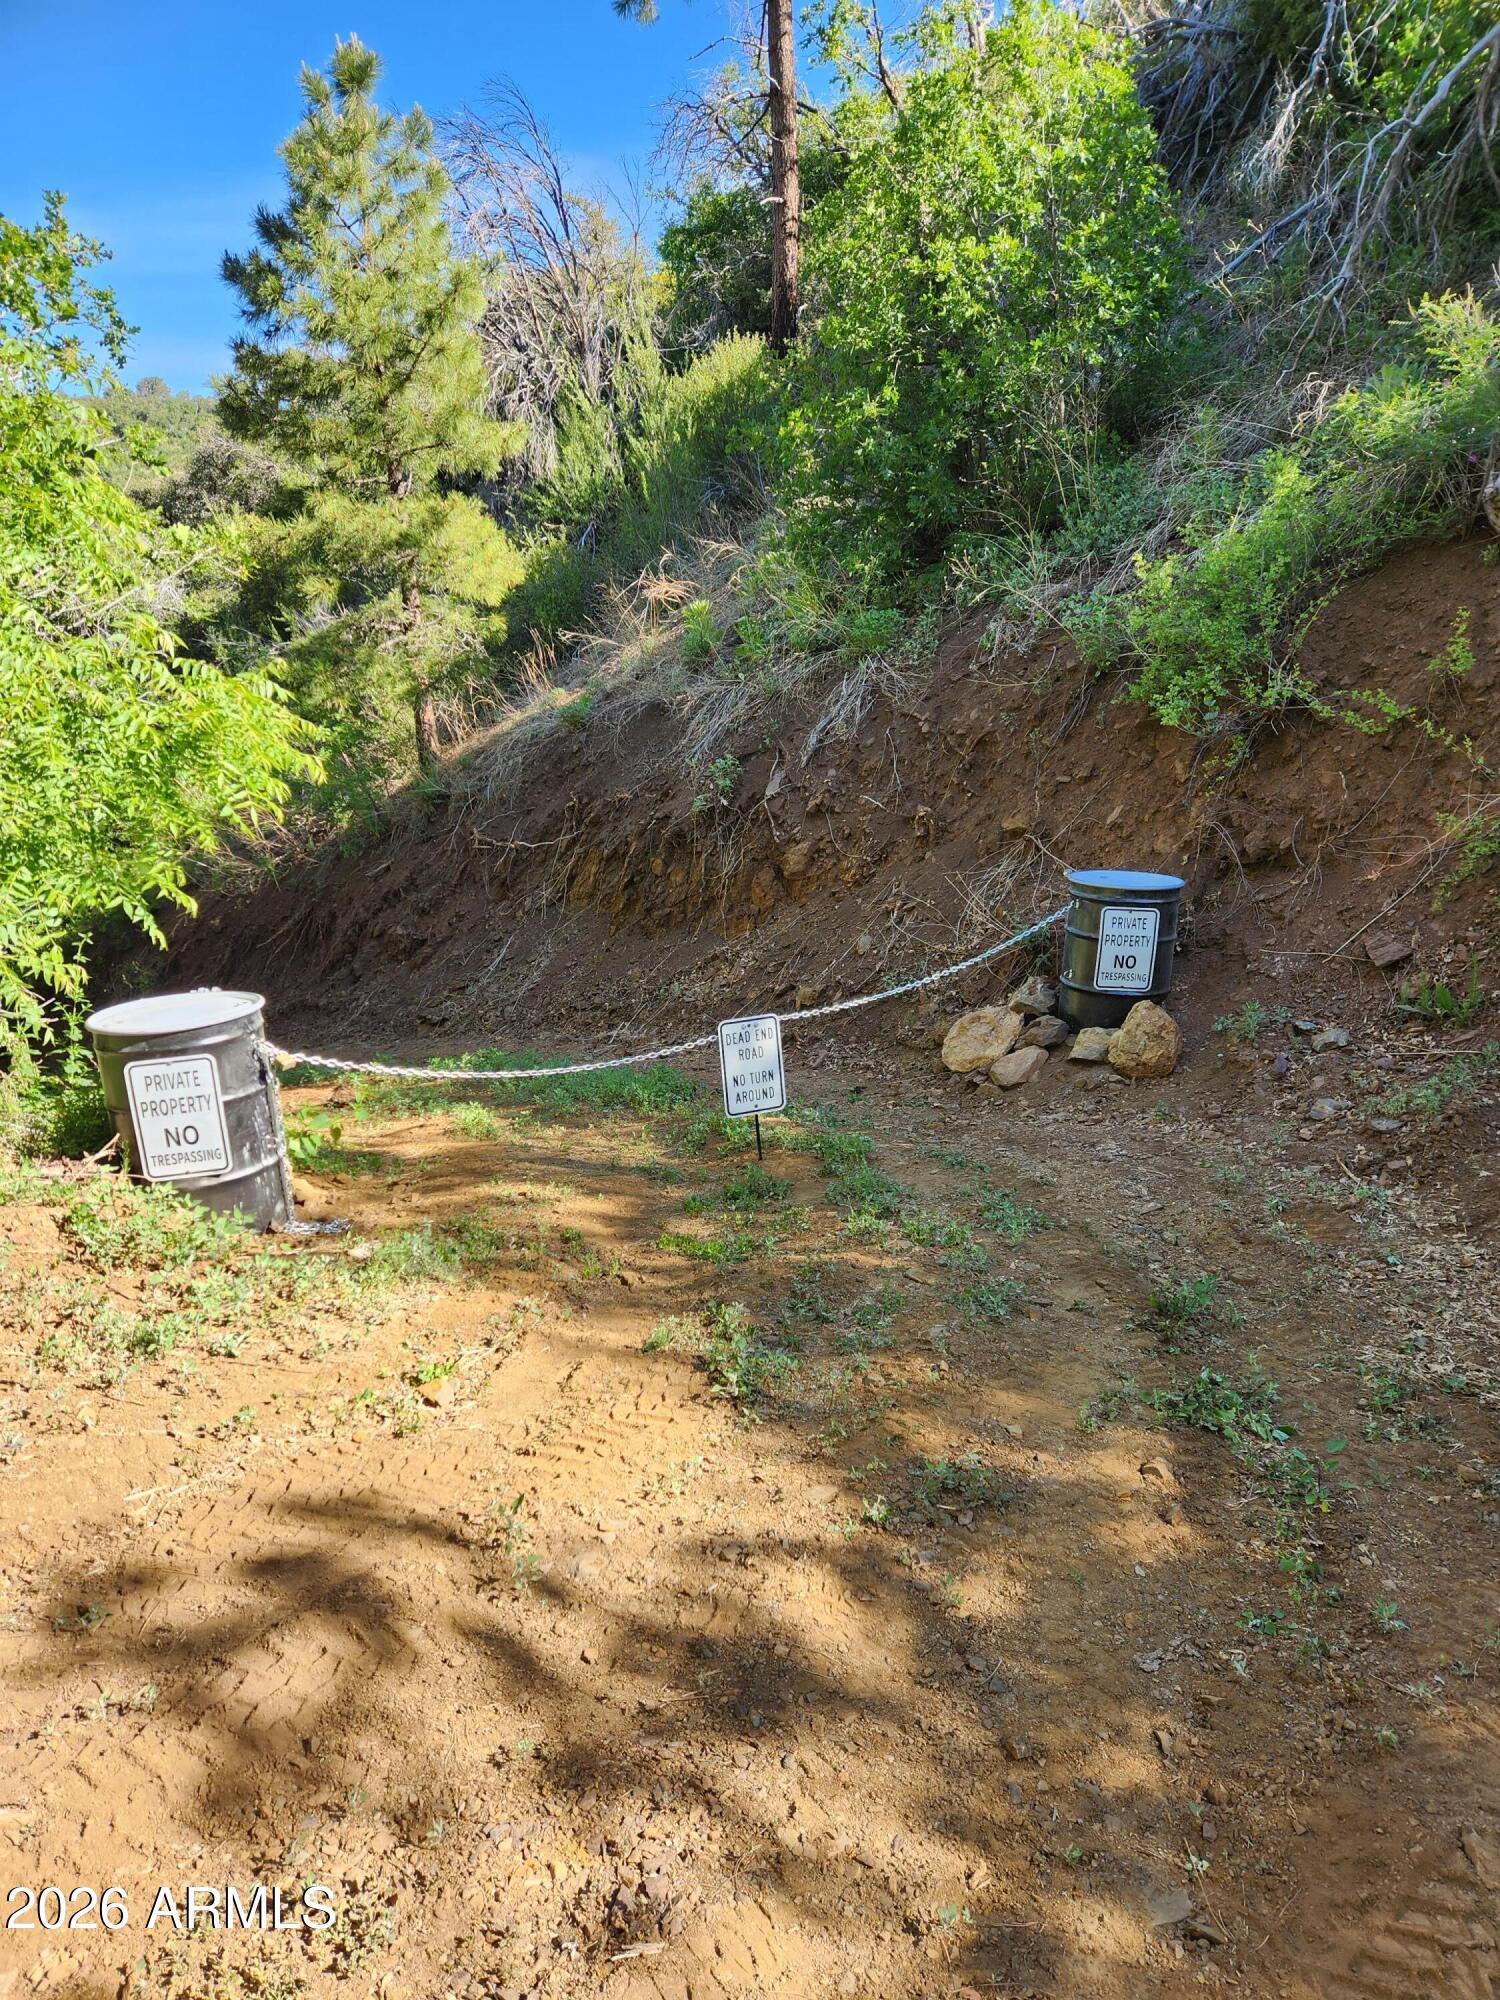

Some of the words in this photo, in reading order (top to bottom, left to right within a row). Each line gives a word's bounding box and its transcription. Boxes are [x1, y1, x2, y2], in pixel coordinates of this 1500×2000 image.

[1111, 916, 1148, 930] PRIVATE
[1104, 934, 1151, 948] PROPERTY
[1113, 954, 1137, 969] NO
[1101, 971, 1147, 983] TRESPASSING
[726, 1030, 751, 1046] DEAD
[755, 1027, 773, 1042] END
[739, 1047, 764, 1061] ROAD
[144, 1070, 201, 1092] PRIVATE
[733, 1074, 745, 1088] NO
[750, 1069, 774, 1084] TURN
[736, 1086, 775, 1104] AROUND
[140, 1094, 211, 1118] PROPERTY
[163, 1125, 199, 1148] NO
[151, 1148, 222, 1168] TRESPASSING
